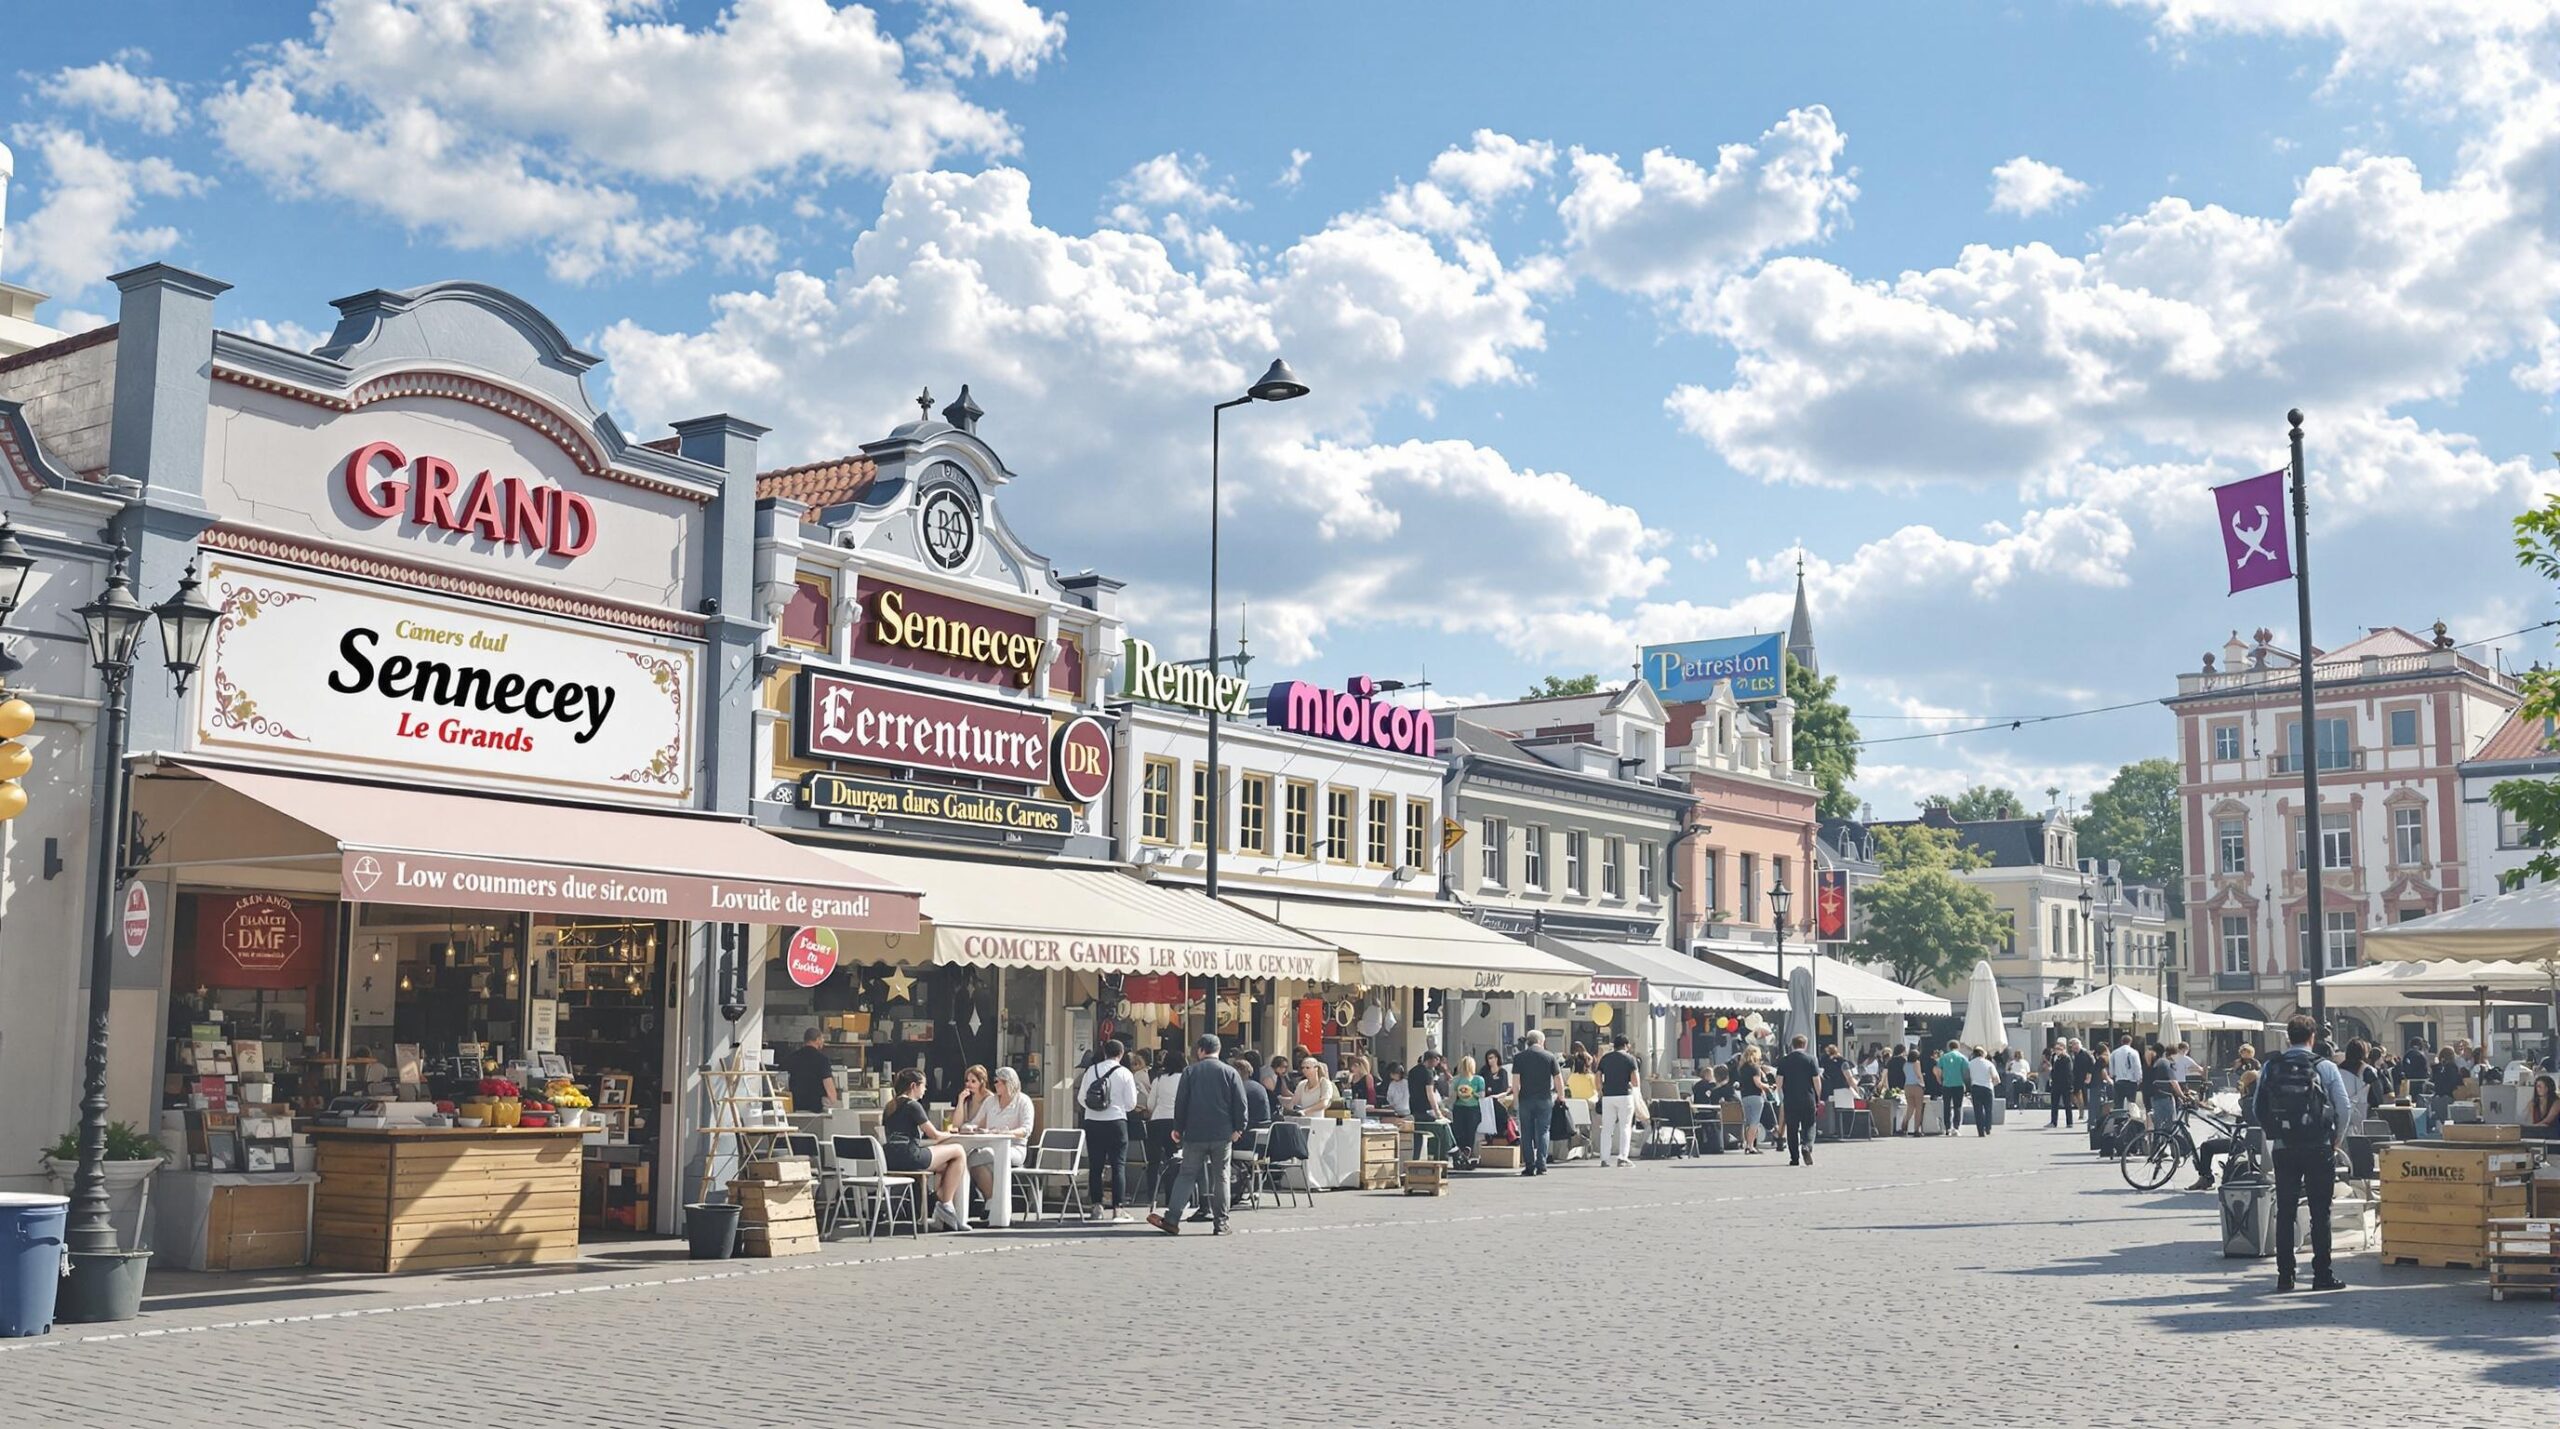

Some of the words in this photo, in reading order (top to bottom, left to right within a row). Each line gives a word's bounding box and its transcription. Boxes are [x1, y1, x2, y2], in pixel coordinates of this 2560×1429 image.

[345, 441, 598, 557] GRAND
[878, 590, 1045, 686] Sennecey
[328, 628, 615, 744] Sennecey
[1130, 638, 1250, 716] Rennez
[396, 712, 429, 739] Le
[438, 718, 533, 752] Grands
[1068, 741, 1103, 777] DR
[396, 861, 447, 888] Low
[785, 891, 807, 913] de
[811, 895, 870, 919] grand!
[964, 935, 1061, 962] COMCER
[1149, 946, 1176, 968] LER
